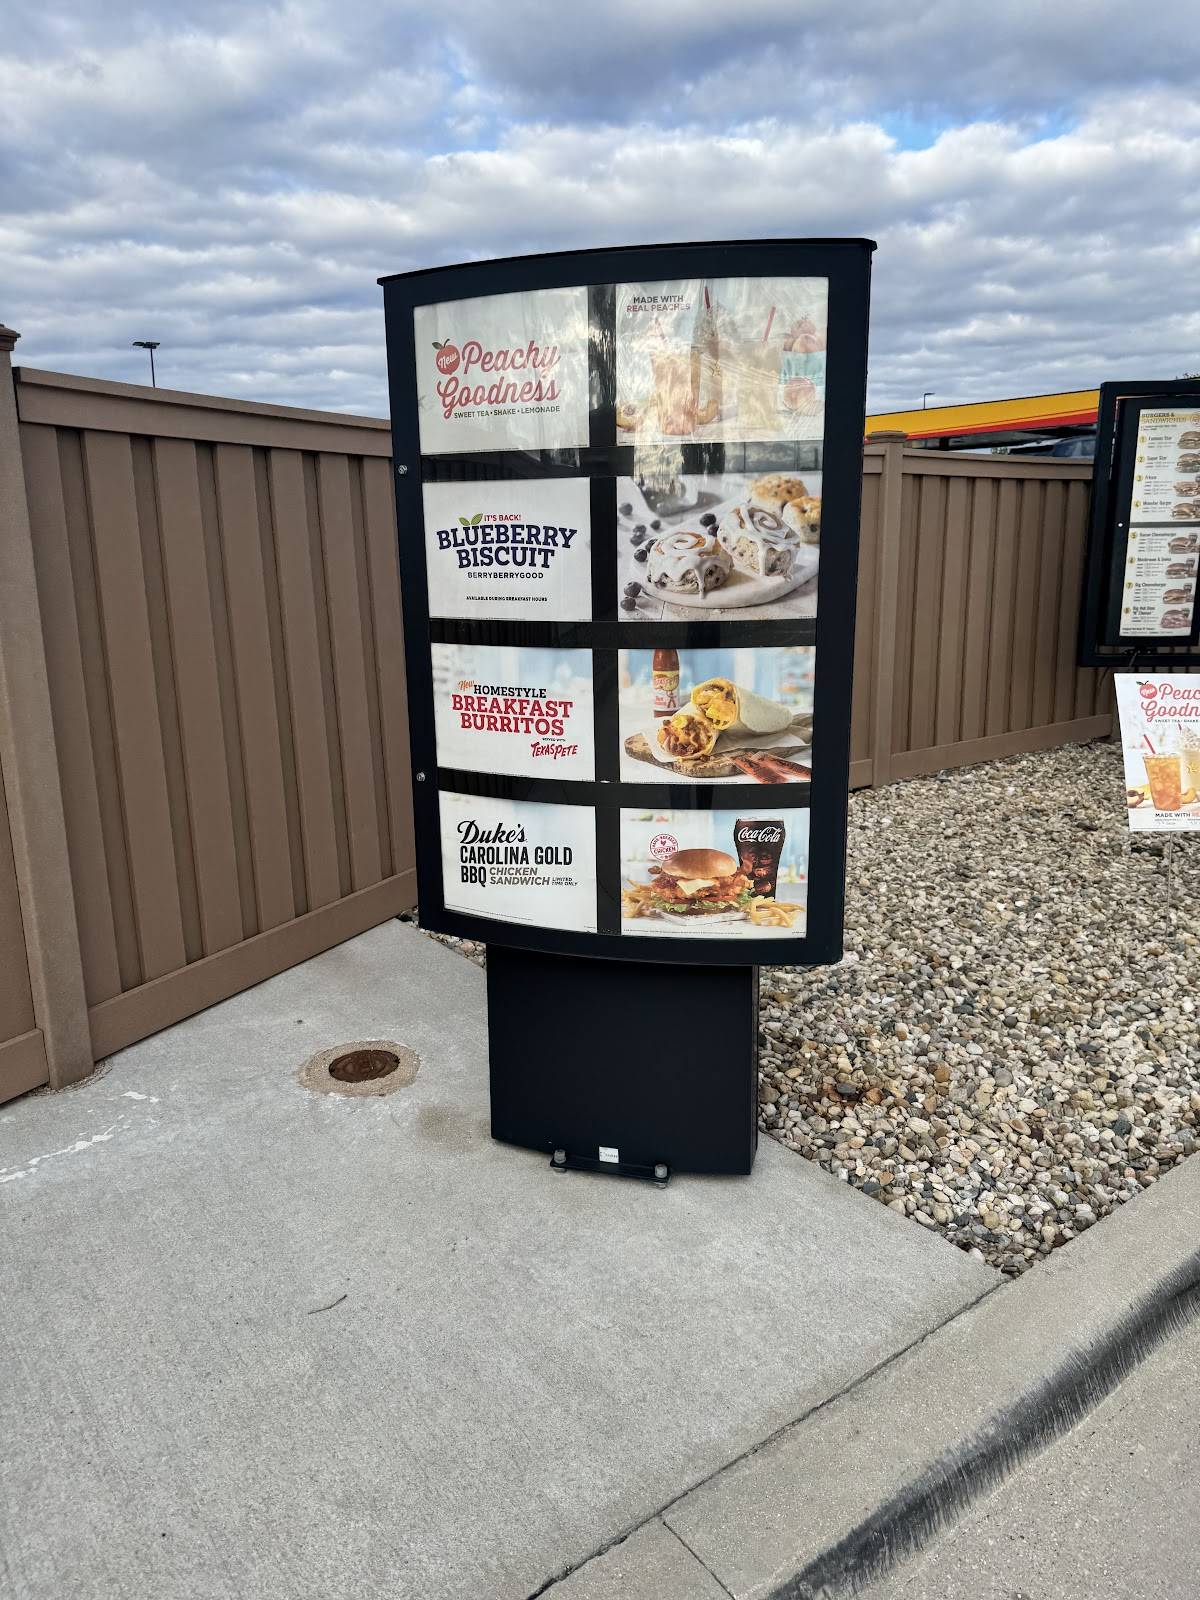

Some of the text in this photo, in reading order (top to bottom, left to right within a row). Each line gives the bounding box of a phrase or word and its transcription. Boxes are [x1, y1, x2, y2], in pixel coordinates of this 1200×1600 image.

[626, 303, 691, 312] REAL PEACHES
[634, 295, 684, 304] MADE WITH
[438, 340, 561, 379] New Peachy
[437, 376, 561, 419] Goodness
[454, 405, 561, 419] SWEET TEA SHAKE LEMONADE
[484, 514, 521, 522] IT'S BACK!
[436, 524, 578, 550] BLUEBERRY
[456, 546, 555, 568] BISCUIT
[473, 685, 547, 698] HOMESTYLE
[452, 694, 573, 718] BREAKFAST
[460, 713, 564, 736] BURRITOS
[457, 820, 527, 844] Duke's
[738, 827, 782, 843] Coca-Cola
[460, 846, 573, 865] CAROLINA GOLD
[461, 866, 538, 887] BBQ CHICKEN
[489, 877, 550, 885] SANDWICH
